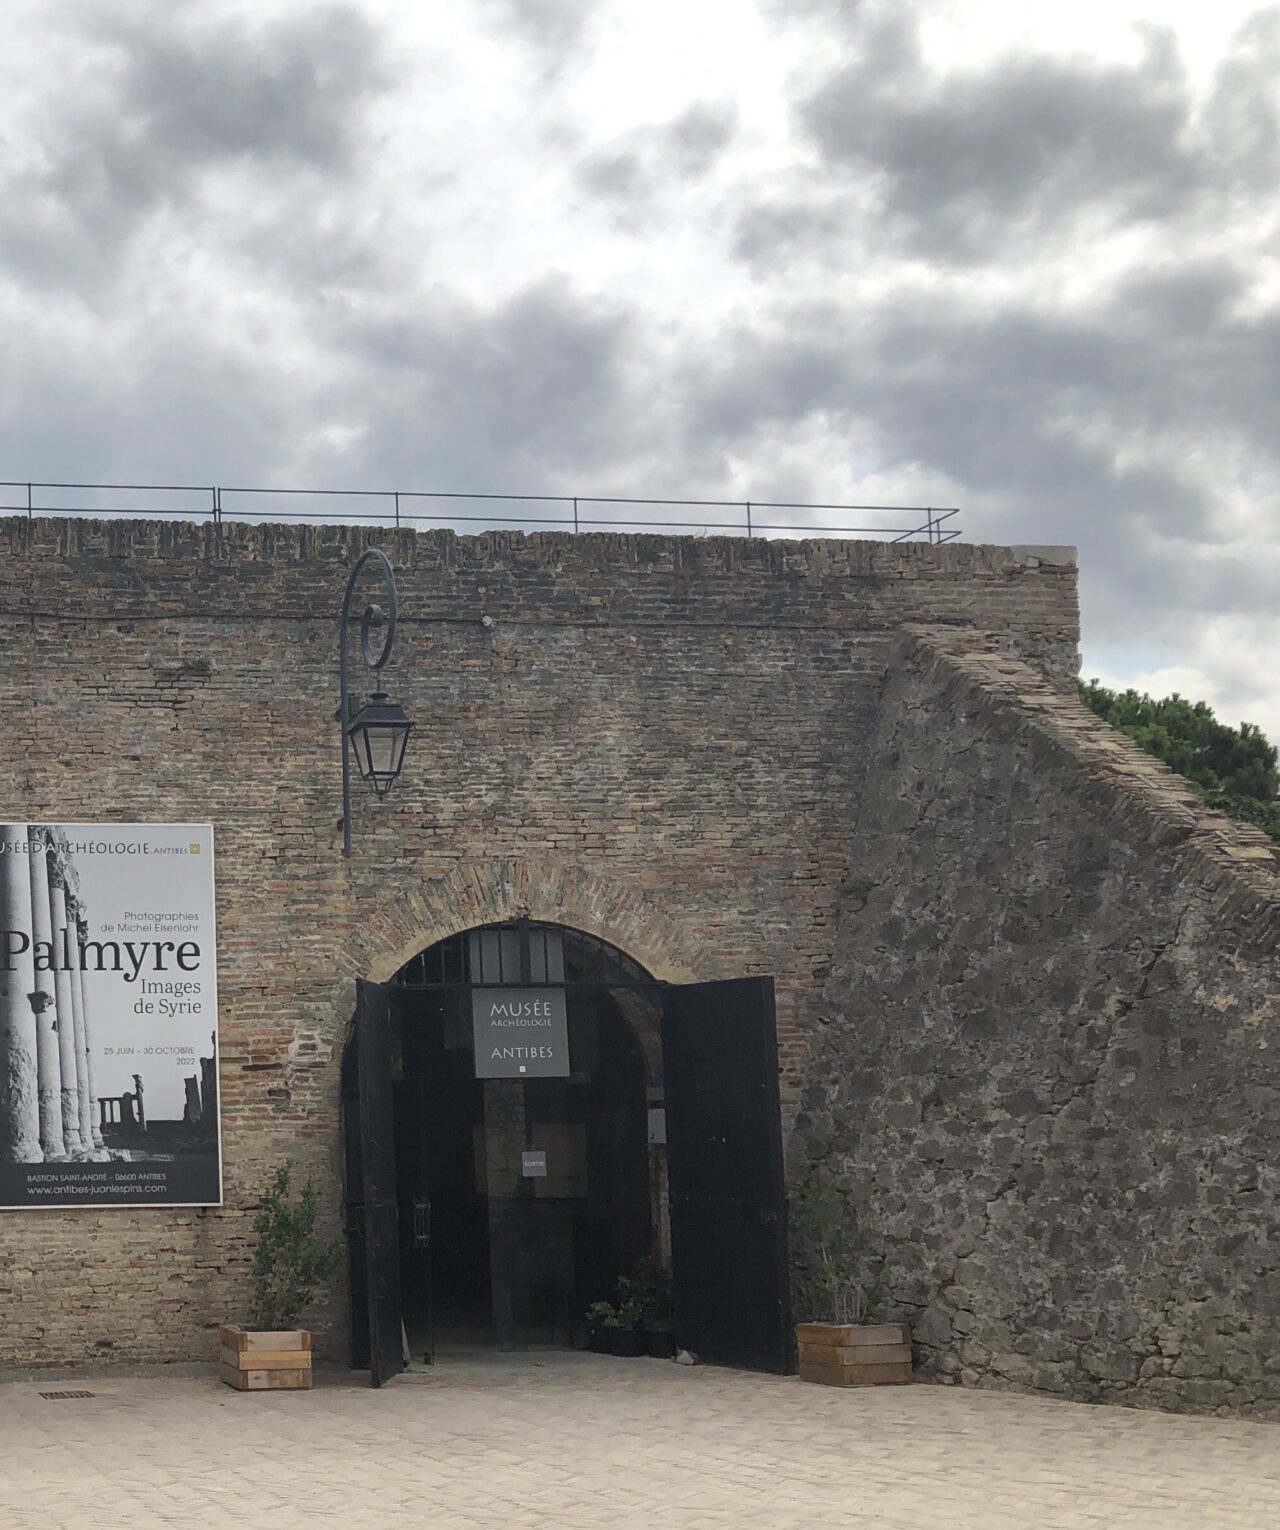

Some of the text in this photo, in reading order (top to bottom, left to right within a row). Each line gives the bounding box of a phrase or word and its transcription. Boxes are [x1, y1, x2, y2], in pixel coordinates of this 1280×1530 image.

[124, 911, 199, 922] Photographies
[100, 923, 199, 932] de Michel Eisenlohr
[141, 978, 202, 998] Images
[133, 998, 202, 1018] de Syrie
[490, 998, 552, 1017] MUSÉE
[103, 1047, 114, 1055] 25
[116, 1047, 135, 1055] JUIN
[143, 1047, 154, 1055] 30
[155, 1046, 196, 1055] OCTOBRE
[491, 1046, 554, 1059] ANTIBES
[176, 1057, 196, 1066] 2022
[27, 1174, 59, 1183] BASTION
[138, 1172, 167, 1181] ANTIBES
[27, 1183, 167, 1195] www.antibes-juanlespins.com
